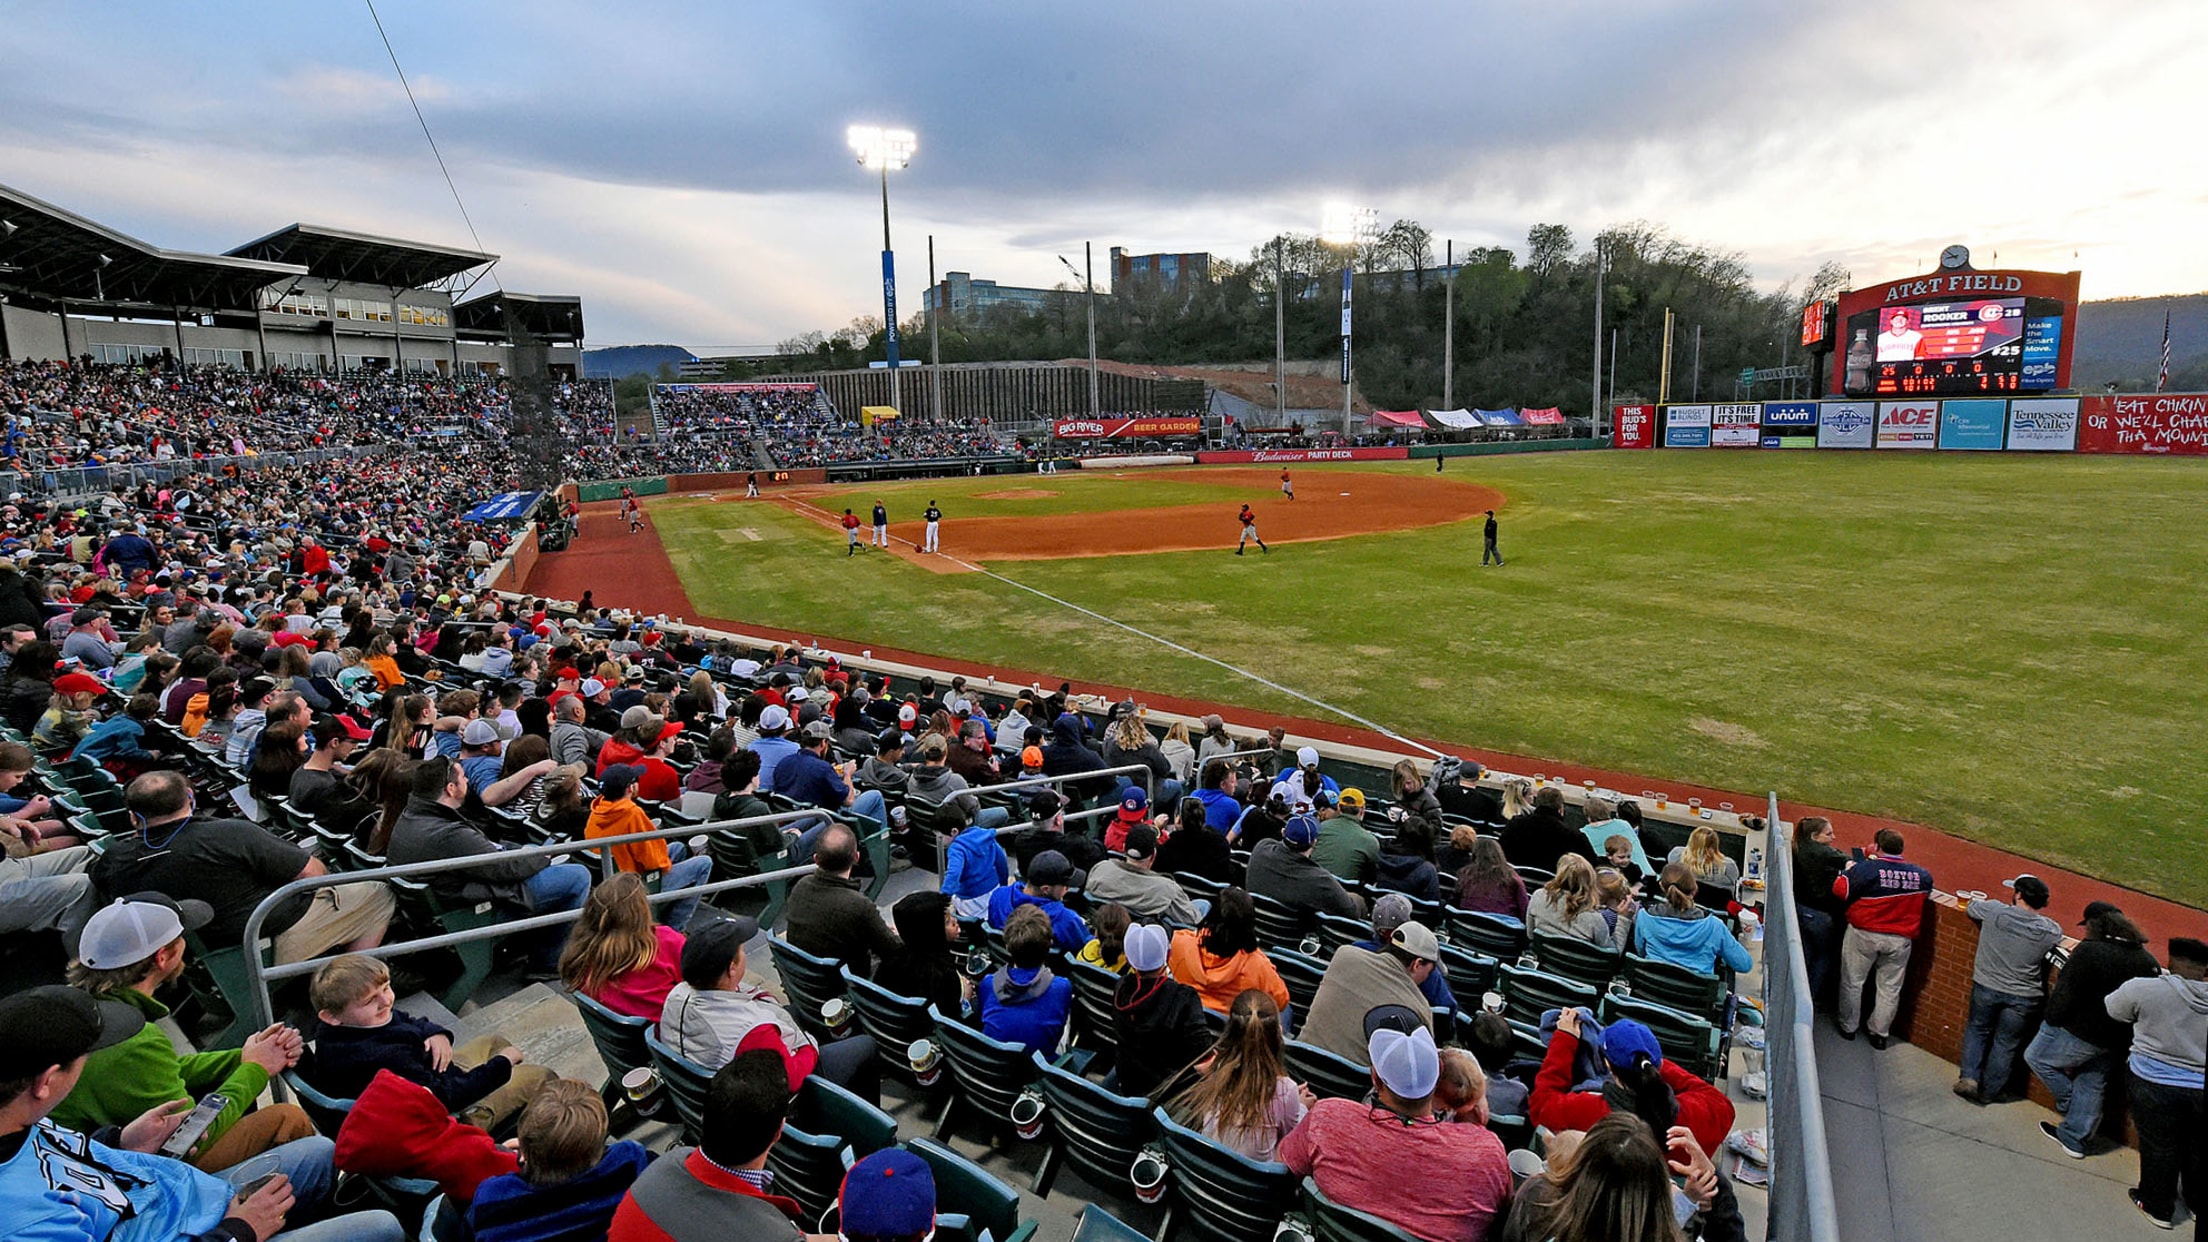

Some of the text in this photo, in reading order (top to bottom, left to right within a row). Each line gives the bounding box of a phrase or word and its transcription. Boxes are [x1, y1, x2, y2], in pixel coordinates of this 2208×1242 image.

[1885, 275, 2022, 302] AT&T FIELD
[1923, 312, 1968, 322] ROOKER
[2027, 321, 2052, 329] Make
[1623, 407, 1642, 416] THIS
[1718, 405, 1757, 415] IT'S FREE
[2116, 398, 2207, 414] EAT CHIKIN
[1622, 415, 1647, 424] BUD'S
[1718, 415, 1756, 423] IT'S TIME
[1881, 405, 1935, 425] ACE
[2013, 409, 2075, 420] Tennessee
[2034, 419, 2074, 432] Valley
[2088, 415, 2109, 430] OR
[2114, 413, 2163, 429] WE'LL
[1059, 421, 1198, 435] BIG RIVER BEER GARDEN
[1622, 424, 1638, 432] FOR
[1622, 432, 1641, 441] YOU.
[2117, 429, 2148, 444] THA
[1251, 450, 1352, 462] Budweiser PARTY DECK
